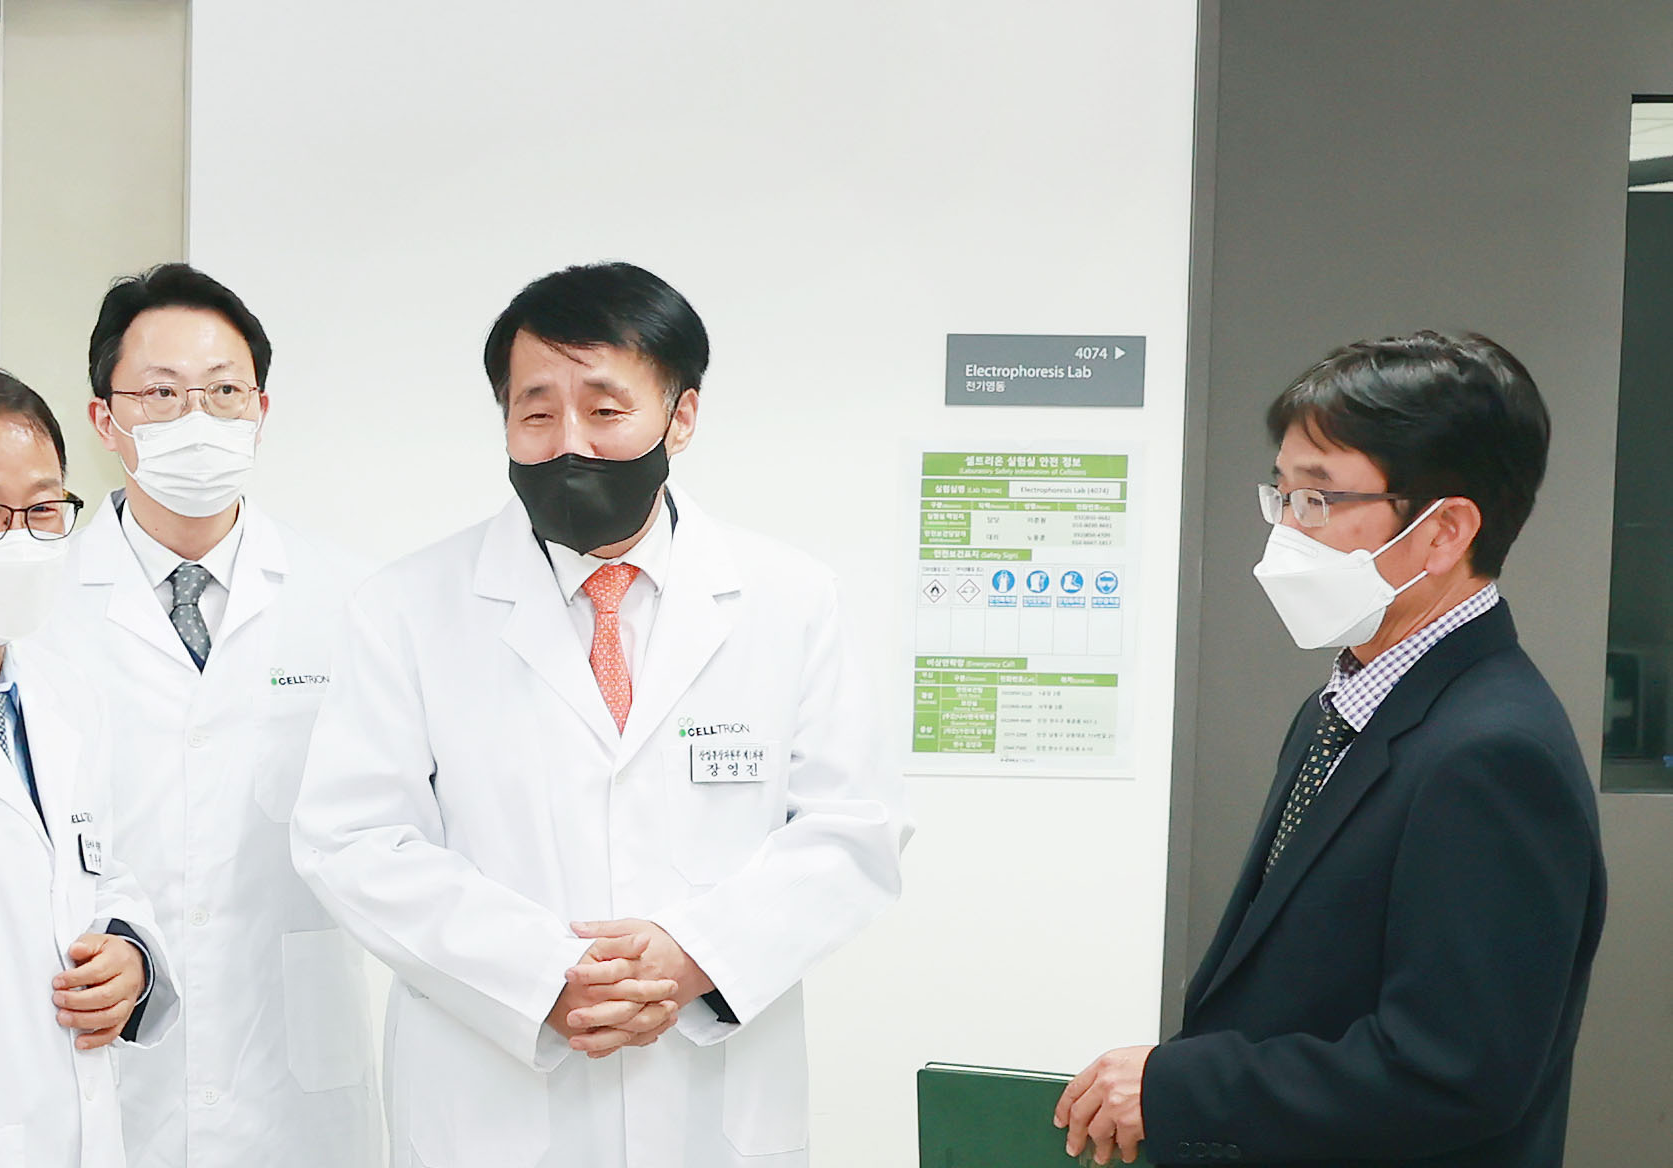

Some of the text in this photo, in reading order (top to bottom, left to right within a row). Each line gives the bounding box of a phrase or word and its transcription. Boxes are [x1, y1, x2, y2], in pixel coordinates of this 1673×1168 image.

[1075, 347, 1108, 360] 4074
[965, 364, 1092, 380] Electrophoresis Lab
[965, 381, 1006, 392] 전기영동
[1039, 456, 1058, 467] 안전
[1062, 457, 1081, 468] 정보
[278, 674, 331, 686] CELLTRION
[687, 722, 750, 738] CELLTRION
